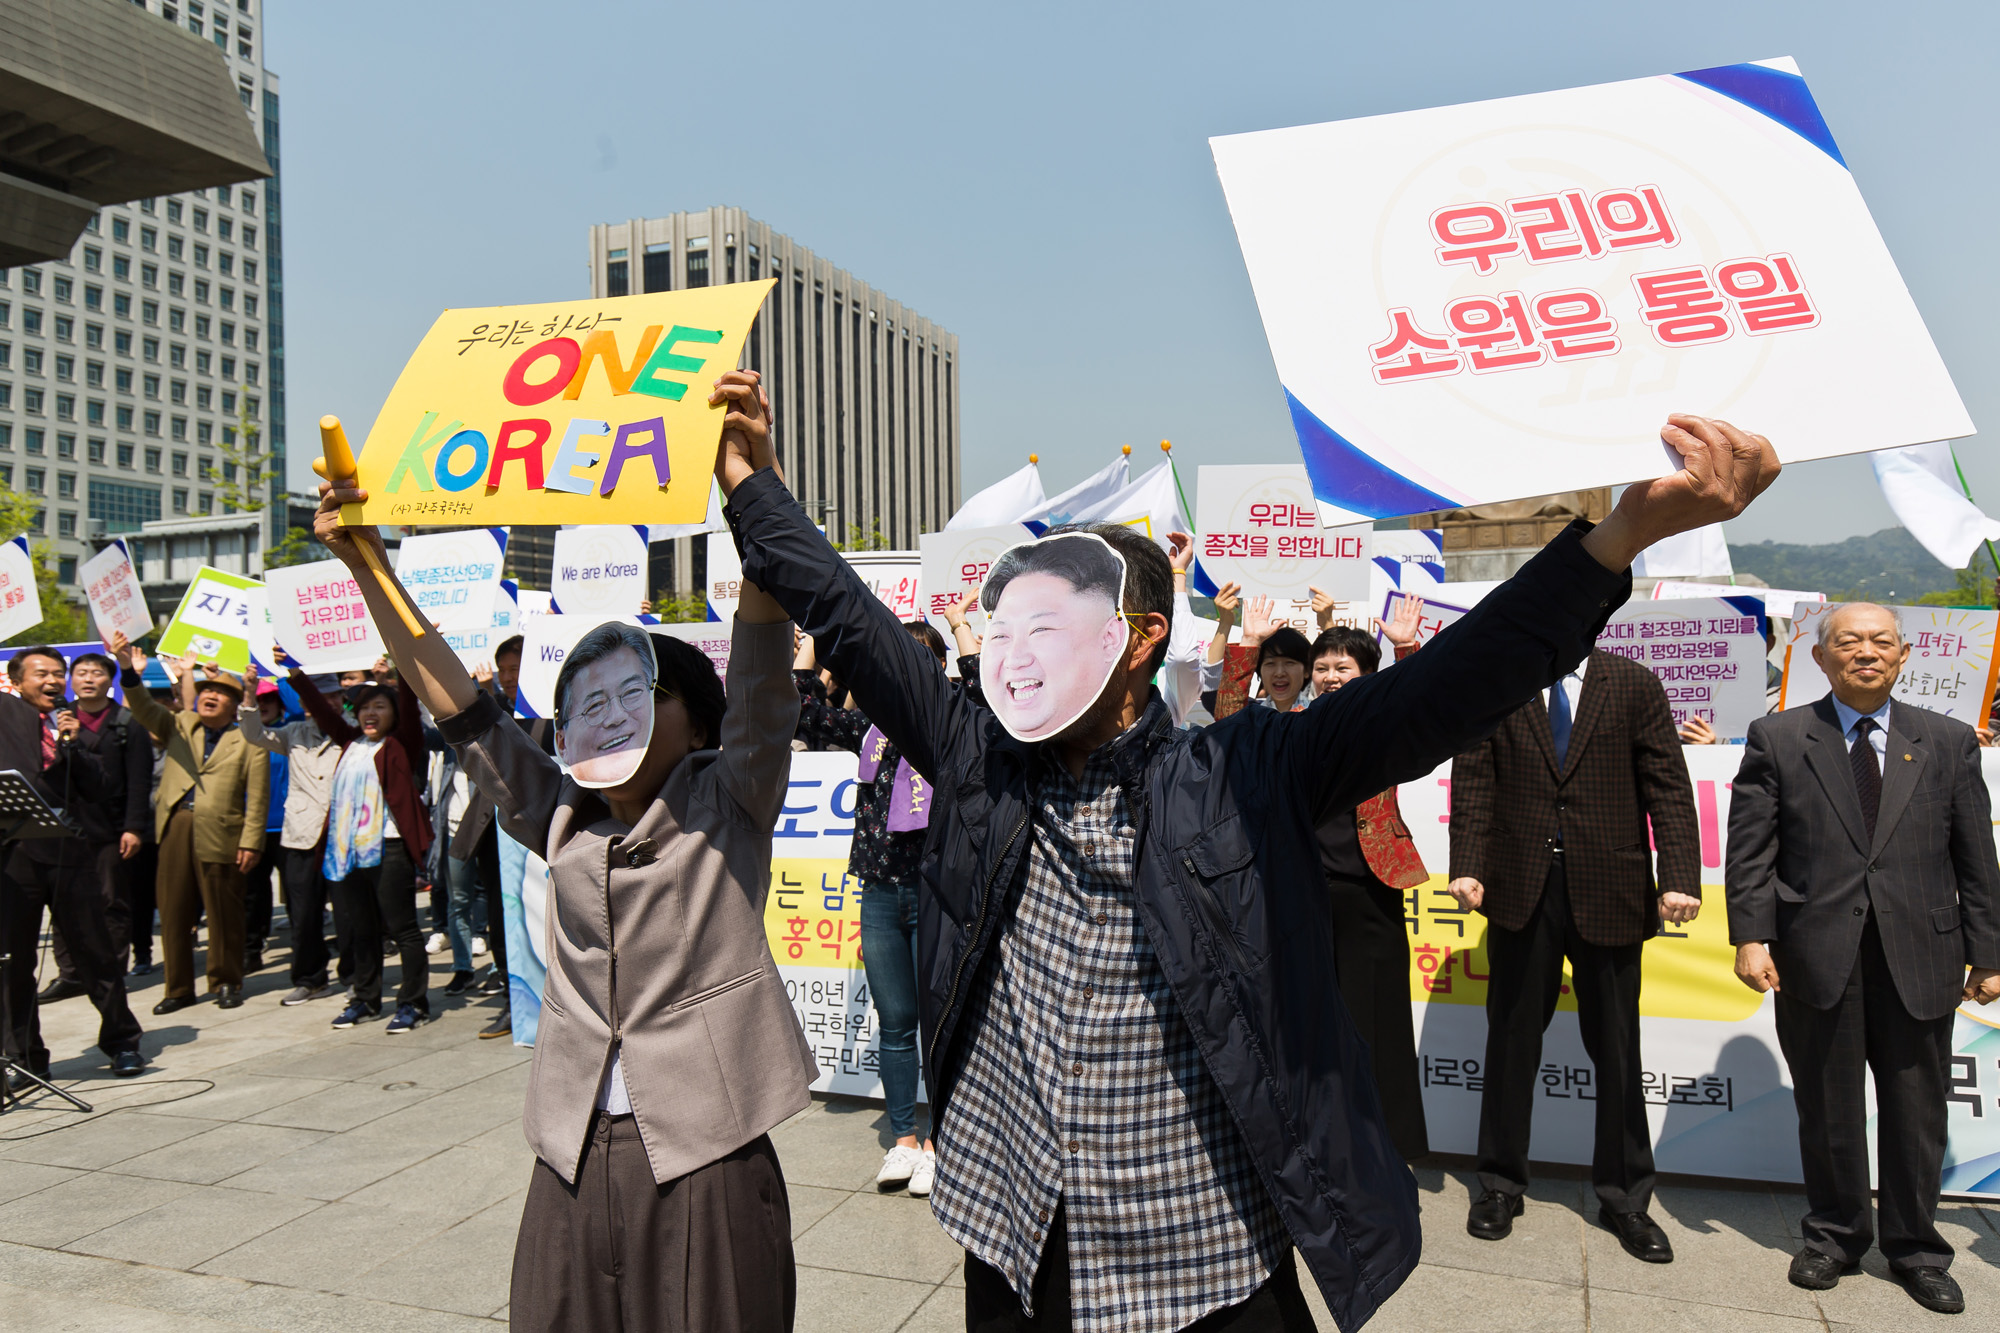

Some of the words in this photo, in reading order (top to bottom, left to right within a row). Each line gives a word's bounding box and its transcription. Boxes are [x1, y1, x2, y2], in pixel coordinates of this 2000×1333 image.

[1433, 188, 1676, 272] 우리의
[1375, 290, 1617, 382] 소원은
[1635, 257, 1816, 345] 통일
[458, 319, 534, 356] 우리는
[503, 325, 725, 406] ONE
[385, 411, 670, 497] KOREA
[391, 503, 411, 515] (사)
[1249, 504, 1316, 528] 우리는
[1204, 534, 1269, 557] 종전을
[1277, 536, 1363, 559] 원합니다
[561, 566, 578, 581] We
[581, 567, 600, 580] are
[604, 562, 638, 578] Korea
[418, 588, 468, 608] 원합니다
[300, 601, 366, 627] 자유화를
[305, 625, 367, 649] 원합니다
[1639, 619, 1703, 639] 철조망과
[1706, 616, 1757, 636] 지뢰를
[541, 645, 564, 662] We
[701, 640, 733, 653] 철조망
[1650, 641, 1729, 661] 평화공원을
[1915, 631, 1968, 658] 평화
[1897, 670, 1967, 699] 상회담
